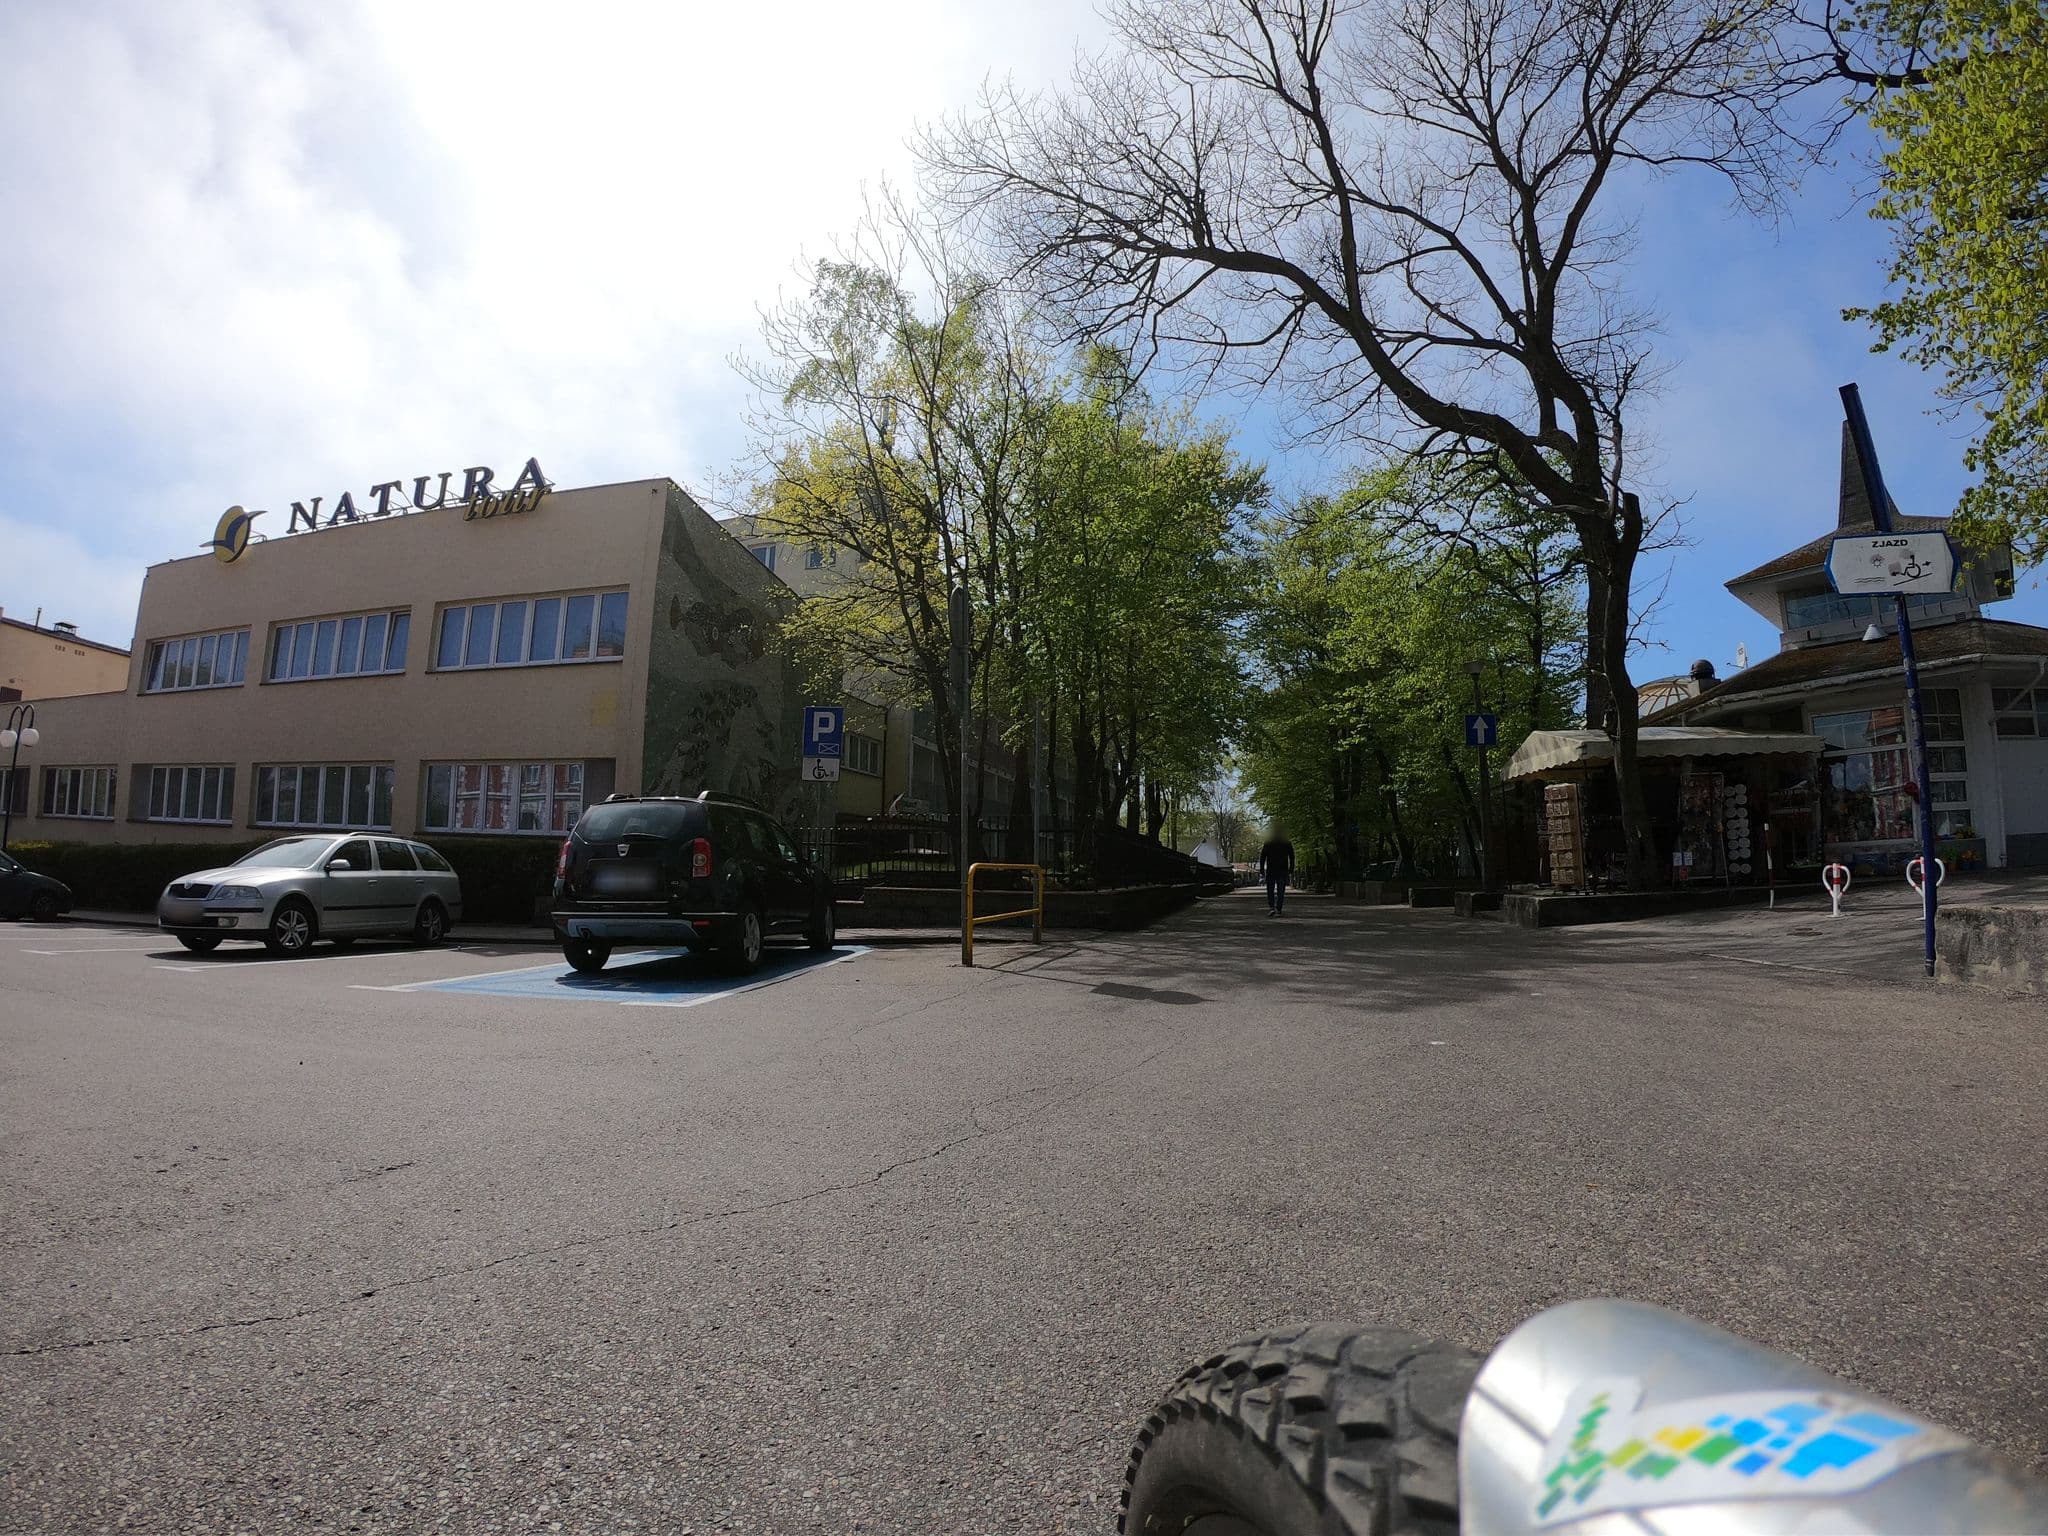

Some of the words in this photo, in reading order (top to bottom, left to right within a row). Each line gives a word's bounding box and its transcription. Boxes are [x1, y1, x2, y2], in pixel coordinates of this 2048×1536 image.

[286, 457, 549, 533] NATURA
[464, 486, 552, 522] tour
[1872, 539, 1908, 548] ZJAZD
[813, 711, 835, 742] P
